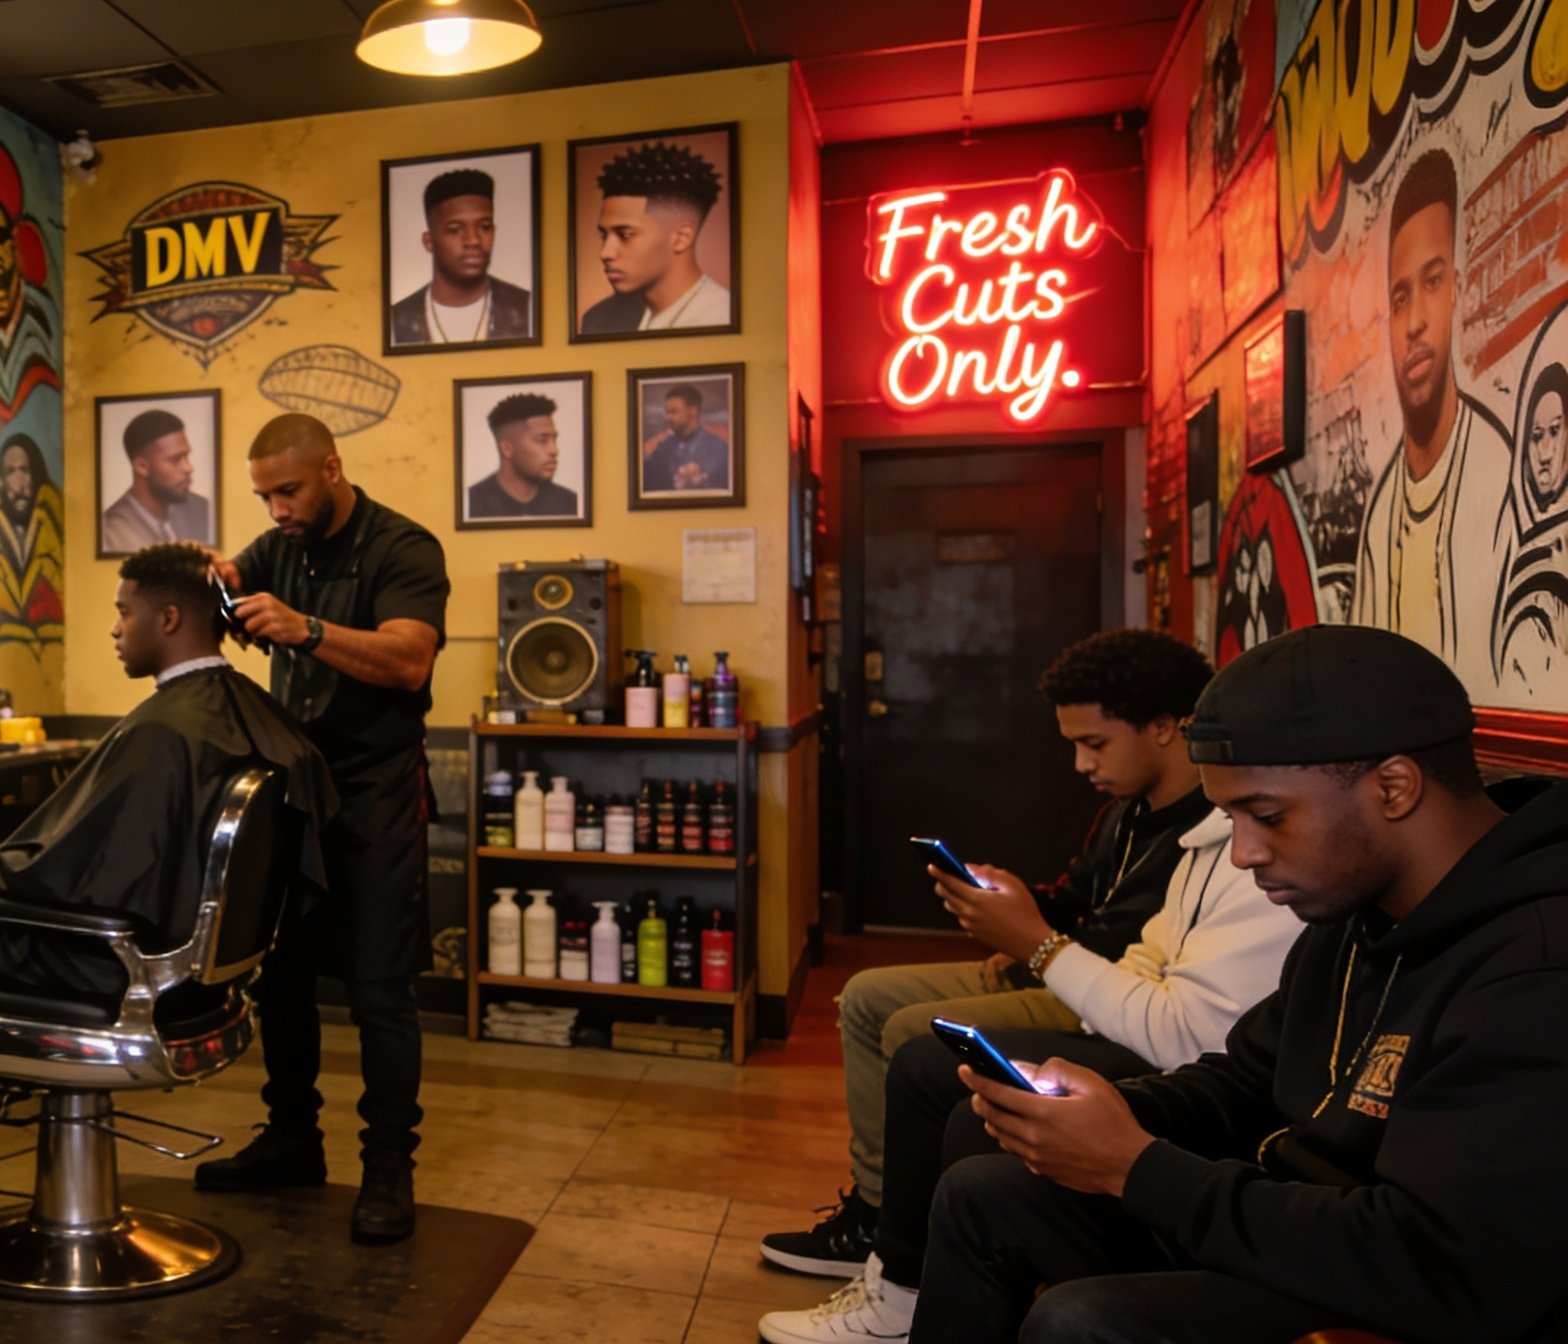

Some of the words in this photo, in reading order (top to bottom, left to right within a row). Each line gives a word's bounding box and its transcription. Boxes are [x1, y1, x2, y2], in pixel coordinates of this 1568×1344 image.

[144, 211, 272, 289] DMV
[878, 177, 1097, 279] Fresh
[902, 261, 1067, 333] Cuts
[888, 324, 1080, 421] Only.
